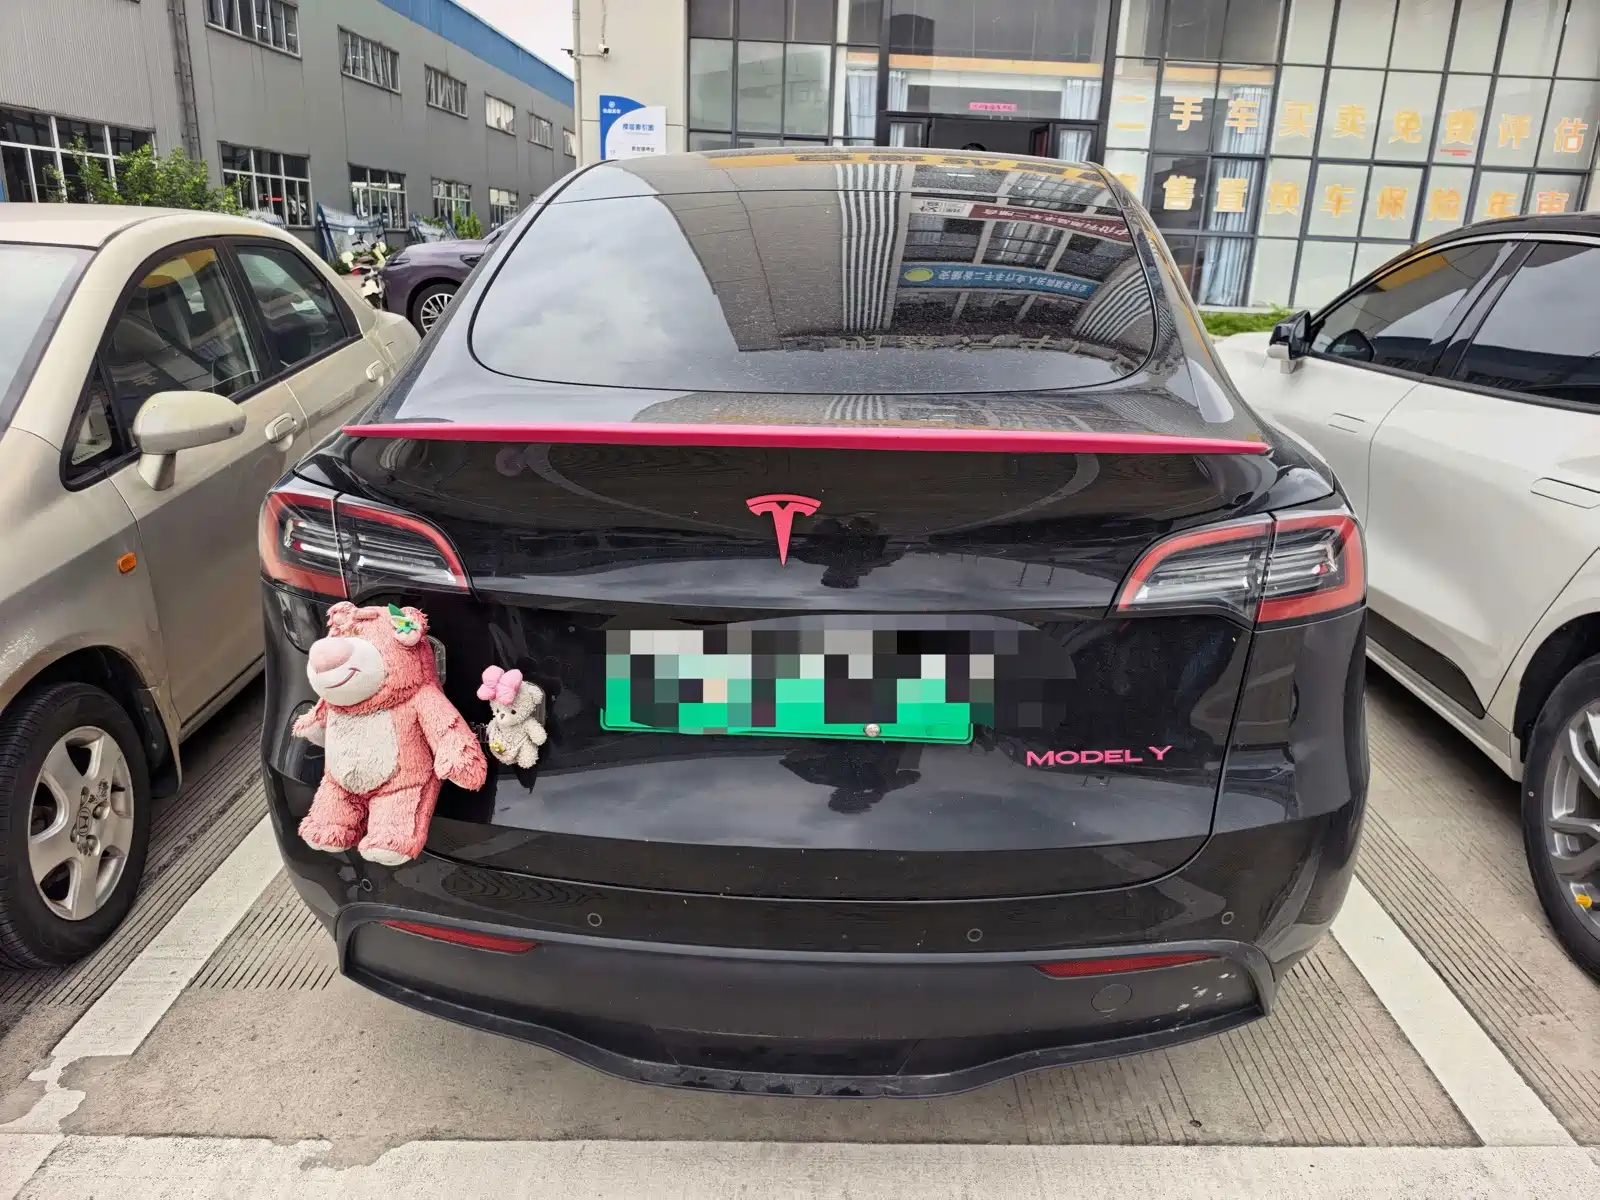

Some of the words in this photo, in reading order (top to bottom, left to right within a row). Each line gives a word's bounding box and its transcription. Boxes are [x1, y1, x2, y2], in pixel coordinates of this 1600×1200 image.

[1116, 94, 1588, 154] 二手车买卖免费评估
[1026, 749, 1144, 767] MODEL
[1148, 745, 1173, 761] Y
